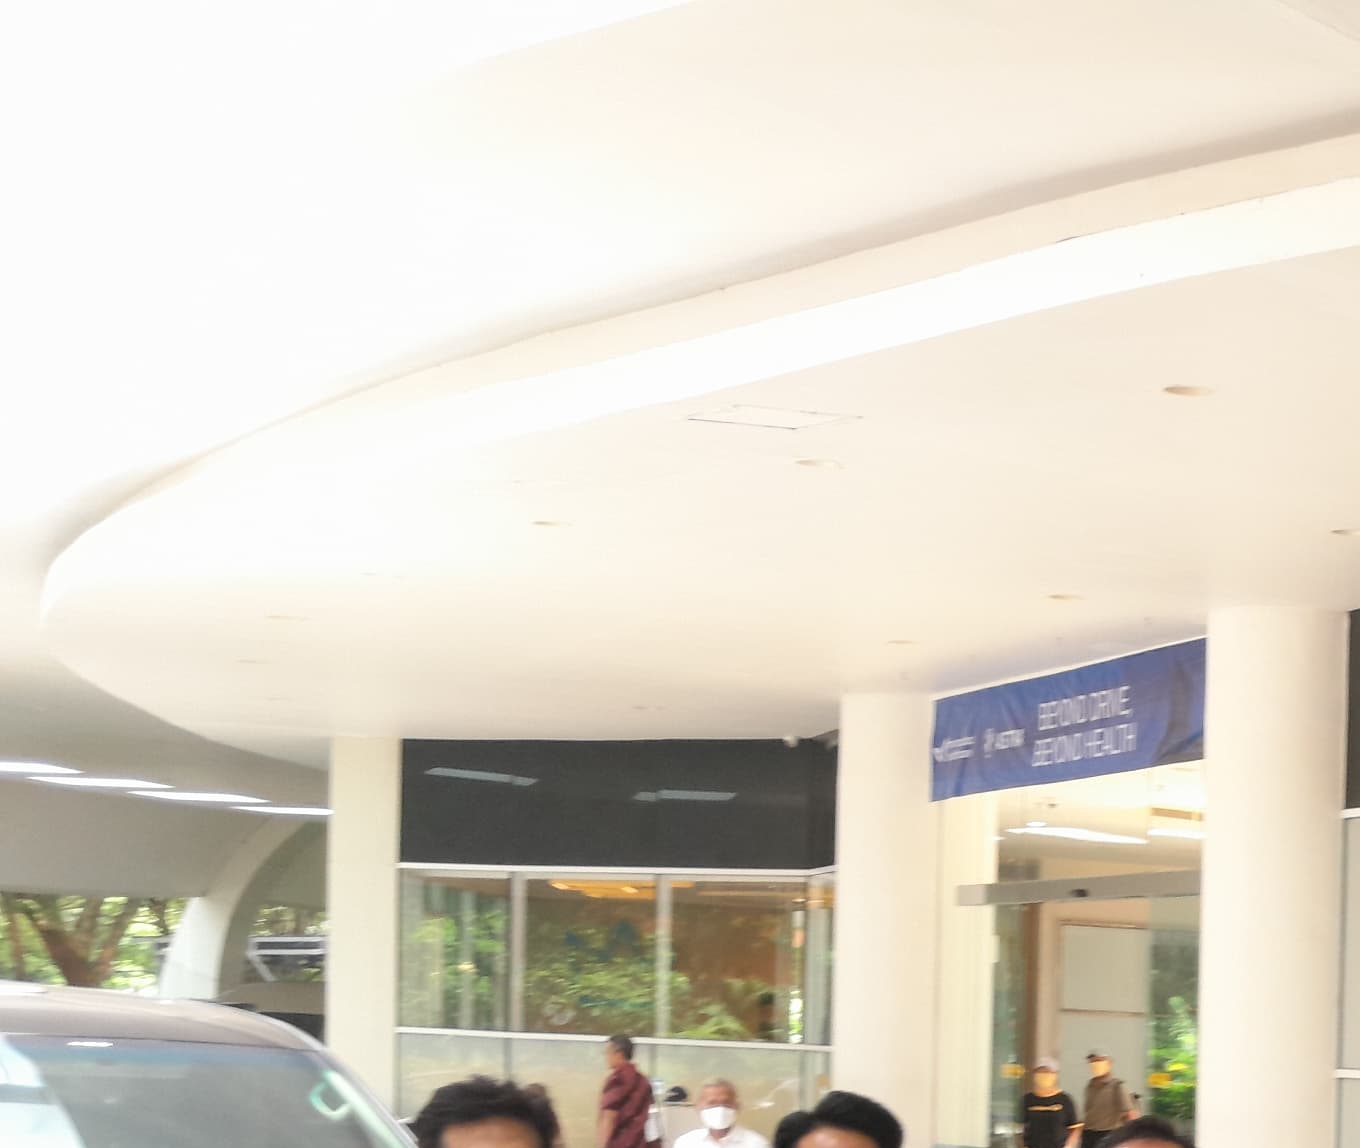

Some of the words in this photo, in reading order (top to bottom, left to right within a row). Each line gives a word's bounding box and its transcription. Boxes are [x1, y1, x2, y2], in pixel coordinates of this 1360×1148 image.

[1038, 694, 1088, 731] BEYOND
[1031, 733, 1084, 767] BEYOND
[1084, 722, 1137, 757] HEALTH
